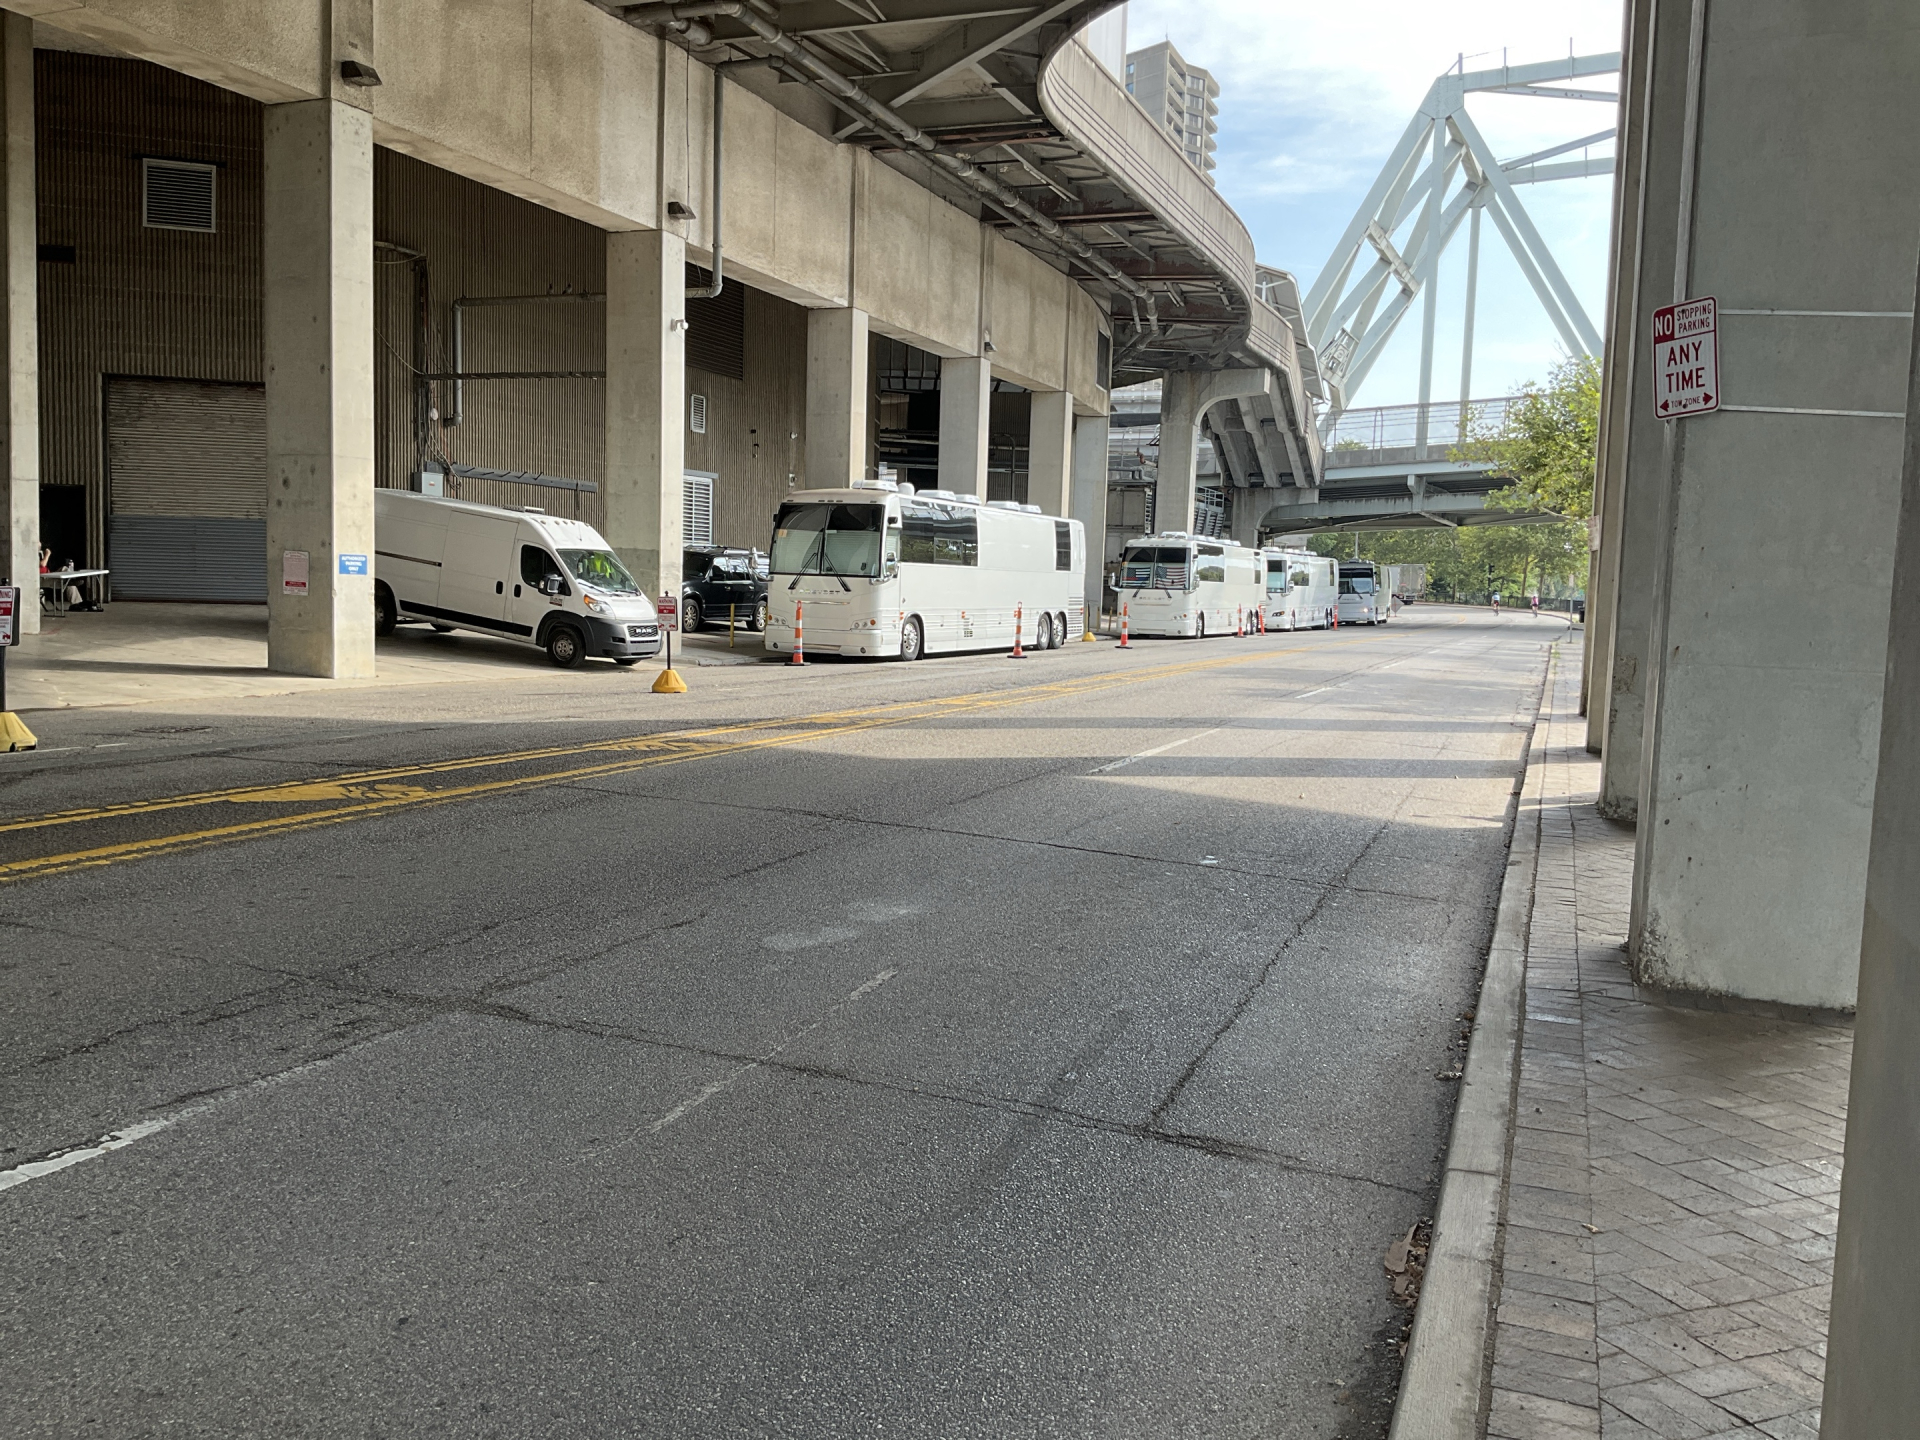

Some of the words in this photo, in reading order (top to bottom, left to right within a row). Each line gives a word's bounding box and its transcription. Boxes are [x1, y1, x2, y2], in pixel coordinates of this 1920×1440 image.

[1676, 303, 1712, 321] STOPPING
[1655, 314, 1673, 337] NO
[1678, 317, 1710, 334] PARKING
[1667, 340, 1702, 367] ANY
[1665, 367, 1705, 393] TIME
[1671, 400, 1683, 408] TOW
[1684, 396, 1701, 406] ZONE
